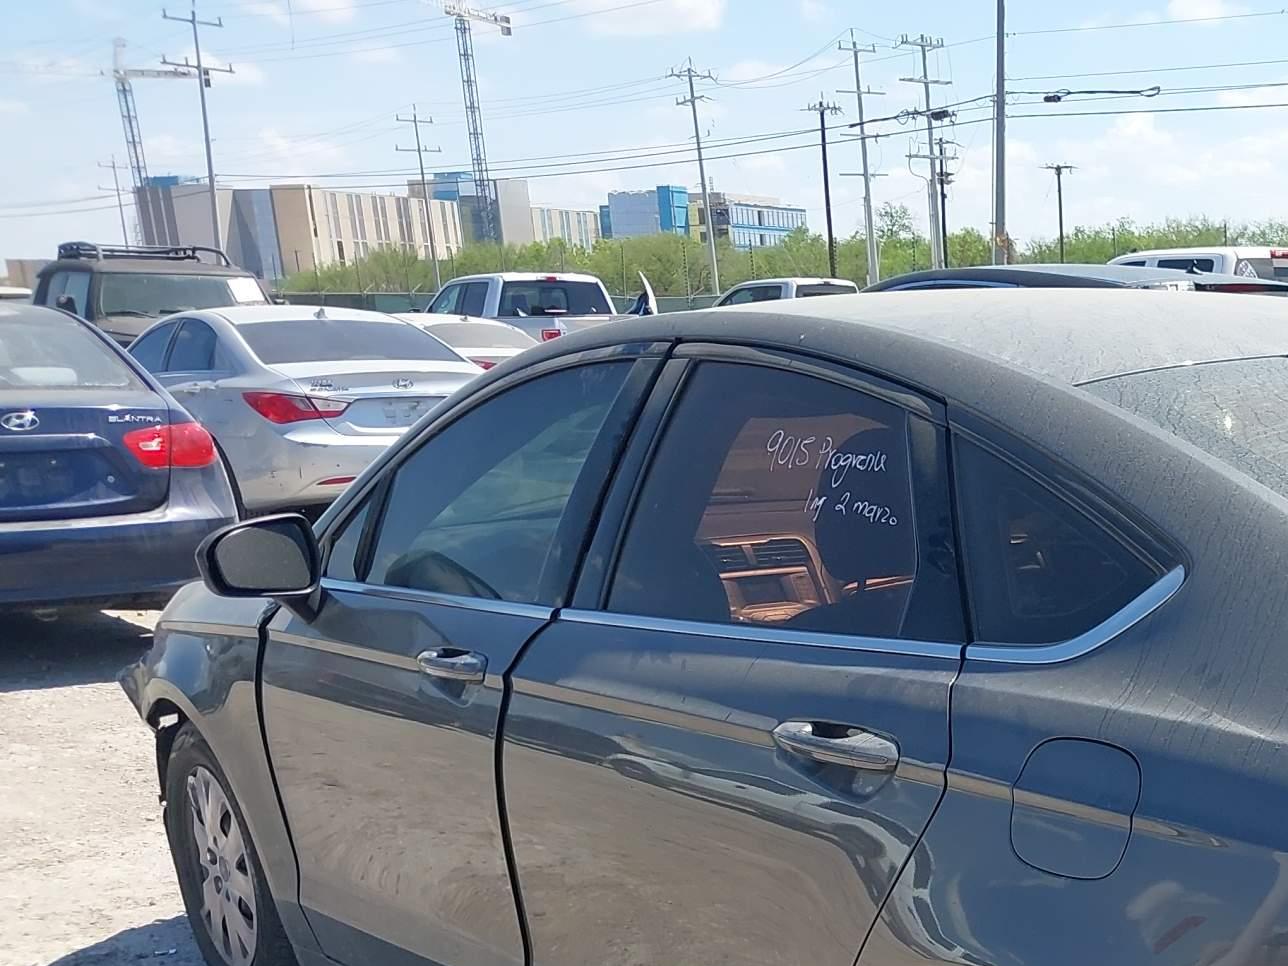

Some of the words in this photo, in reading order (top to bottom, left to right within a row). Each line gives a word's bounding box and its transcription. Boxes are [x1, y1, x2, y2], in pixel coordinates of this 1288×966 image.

[108, 414, 162, 423] ELANTRA
[766, 429, 816, 472] 9015
[834, 491, 851, 515] 2
